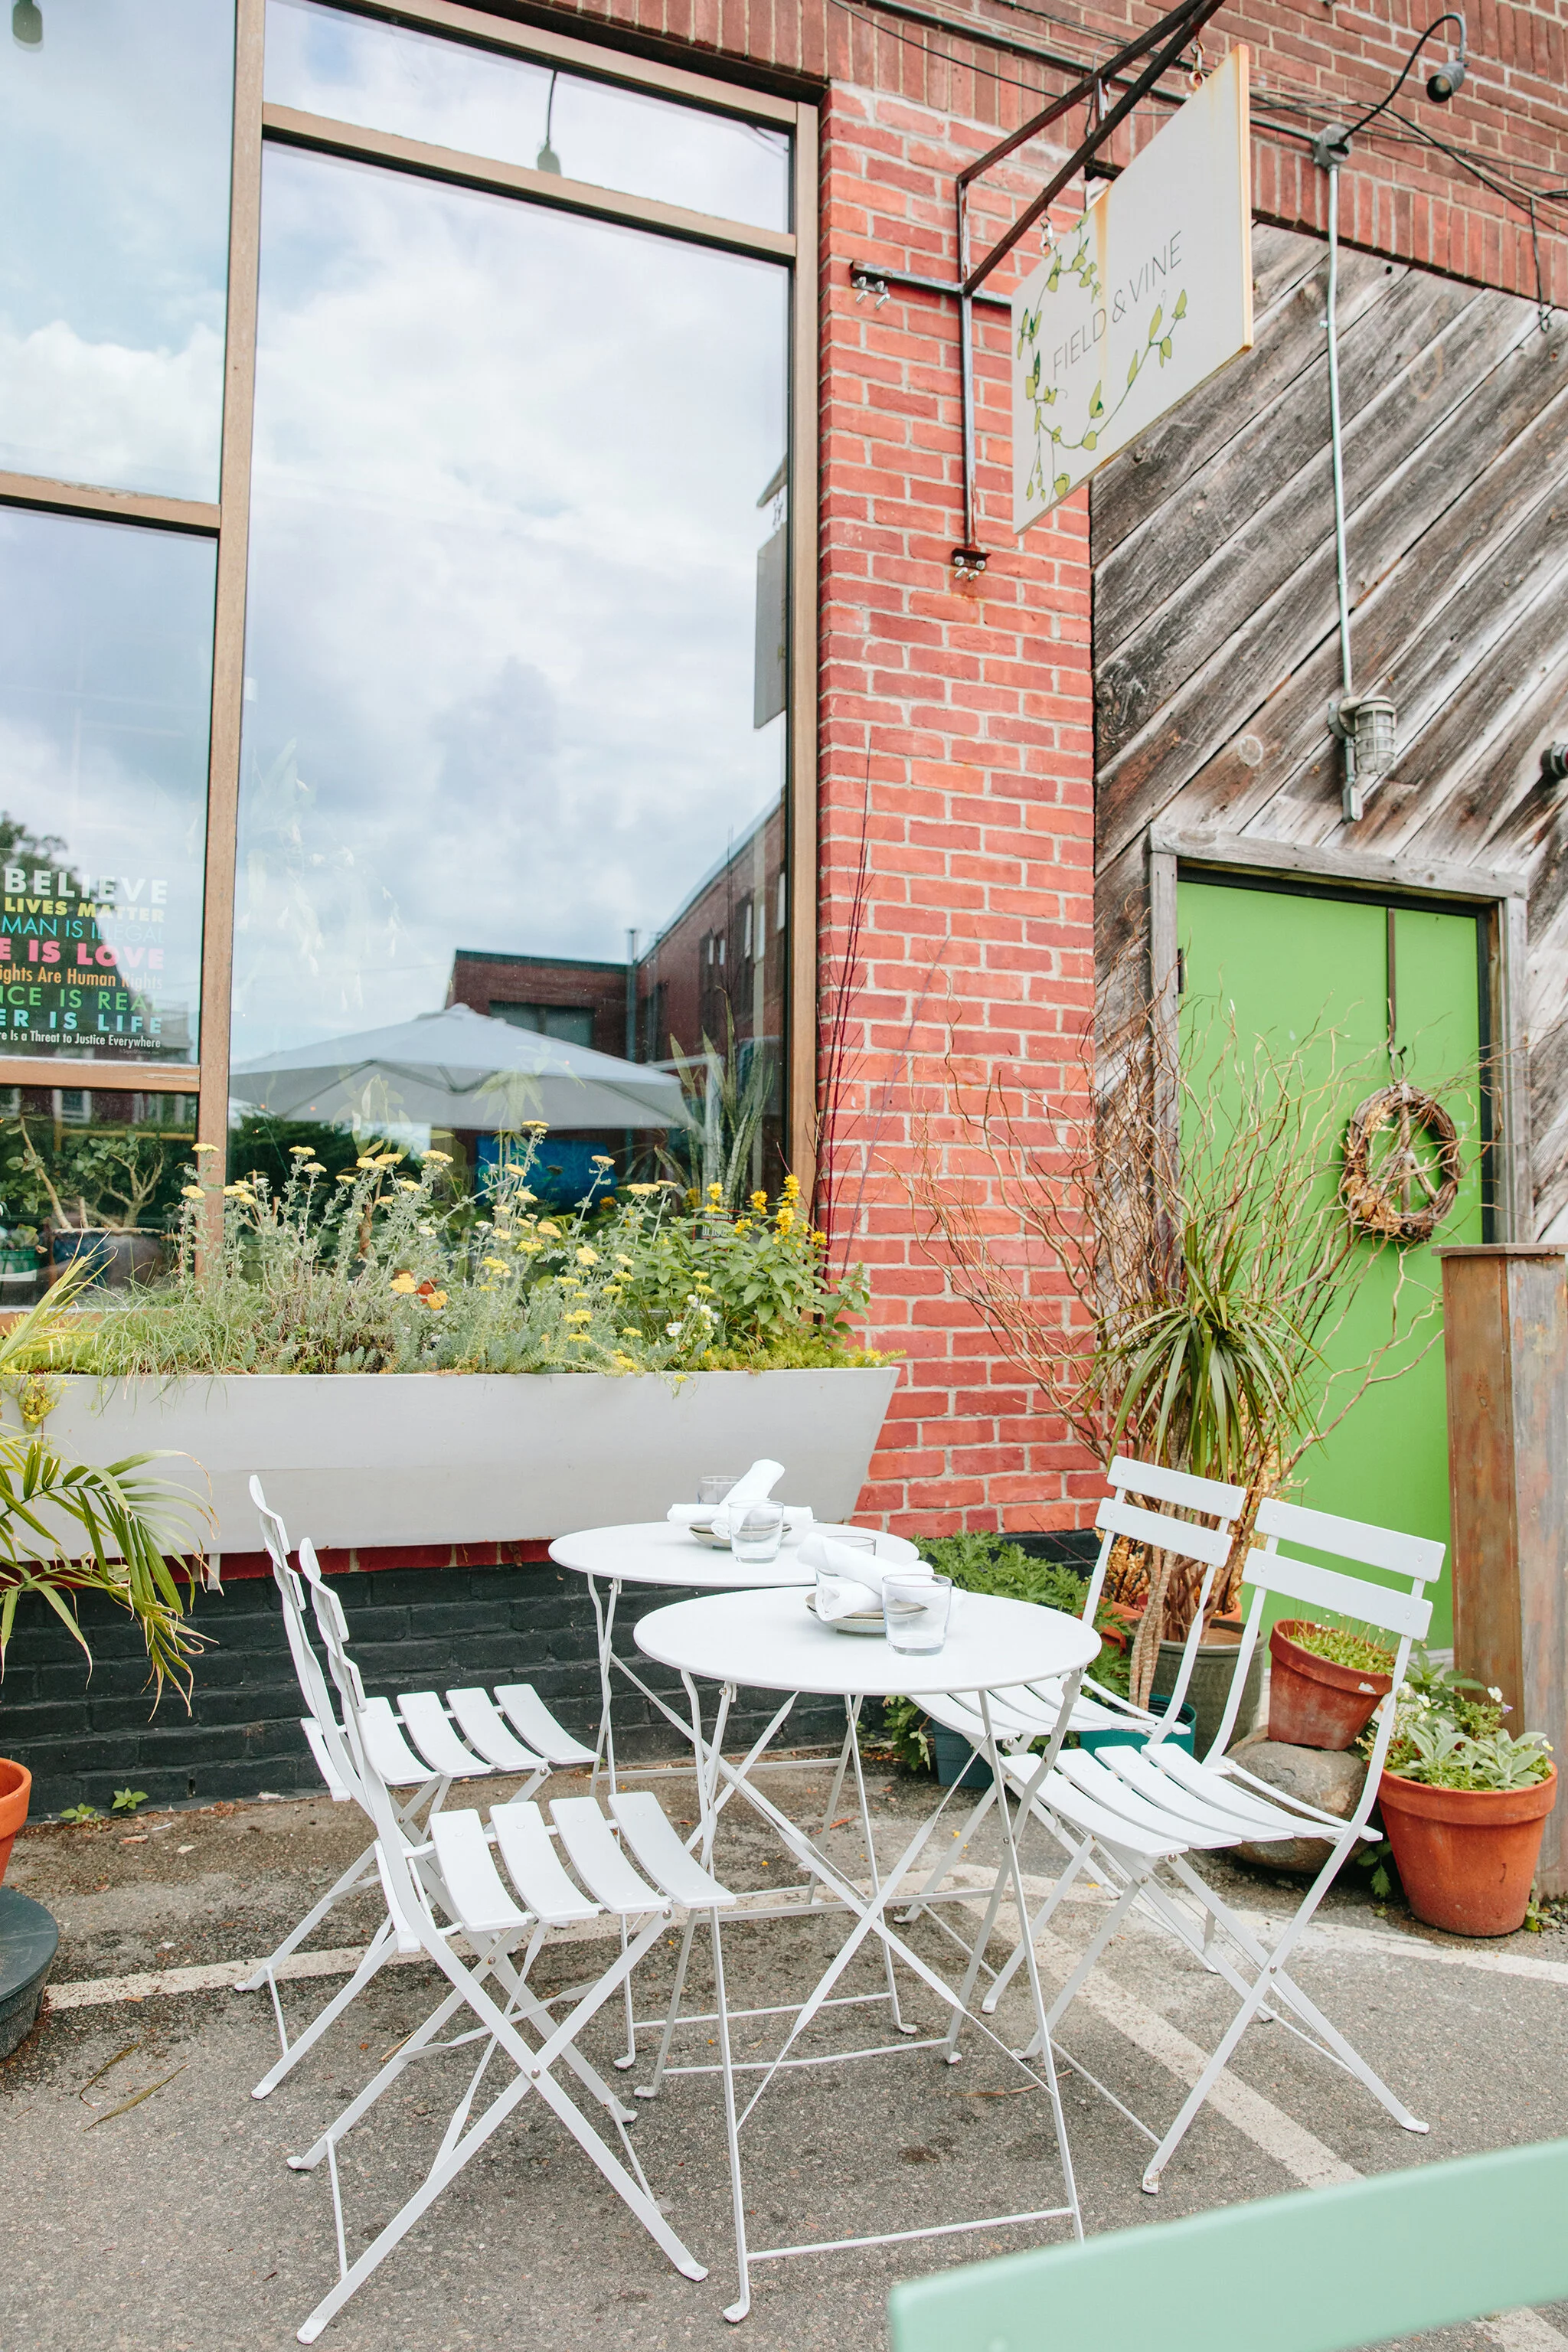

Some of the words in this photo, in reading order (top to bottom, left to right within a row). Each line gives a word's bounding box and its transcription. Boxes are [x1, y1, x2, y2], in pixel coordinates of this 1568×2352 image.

[1054, 308, 1107, 380] FIELD
[1112, 289, 1126, 323] &
[1129, 230, 1181, 302] VINE
[5, 867, 168, 904] BELIEVE
[5, 897, 68, 916] LIVES
[77, 903, 165, 923] MATTER
[2, 915, 57, 936] MAN
[66, 920, 84, 939] IS
[91, 922, 165, 944] ILLEGAL
[28, 939, 60, 964] IS
[77, 942, 164, 970] LOVE
[37, 966, 62, 983] Are
[67, 968, 116, 986] Human
[122, 972, 162, 992] Rights
[0, 985, 41, 1005] CE
[60, 989, 82, 1008] IS
[98, 991, 162, 1013] REAL
[49, 1011, 77, 1030] IS
[97, 1014, 162, 1034] LIFE
[10, 1030, 19, 1041] Is
[21, 1033, 28, 1041] a
[30, 1030, 60, 1043] Threat
[63, 1034, 72, 1044] to
[74, 1033, 106, 1045] Justice
[108, 1034, 161, 1049] Everywhere
